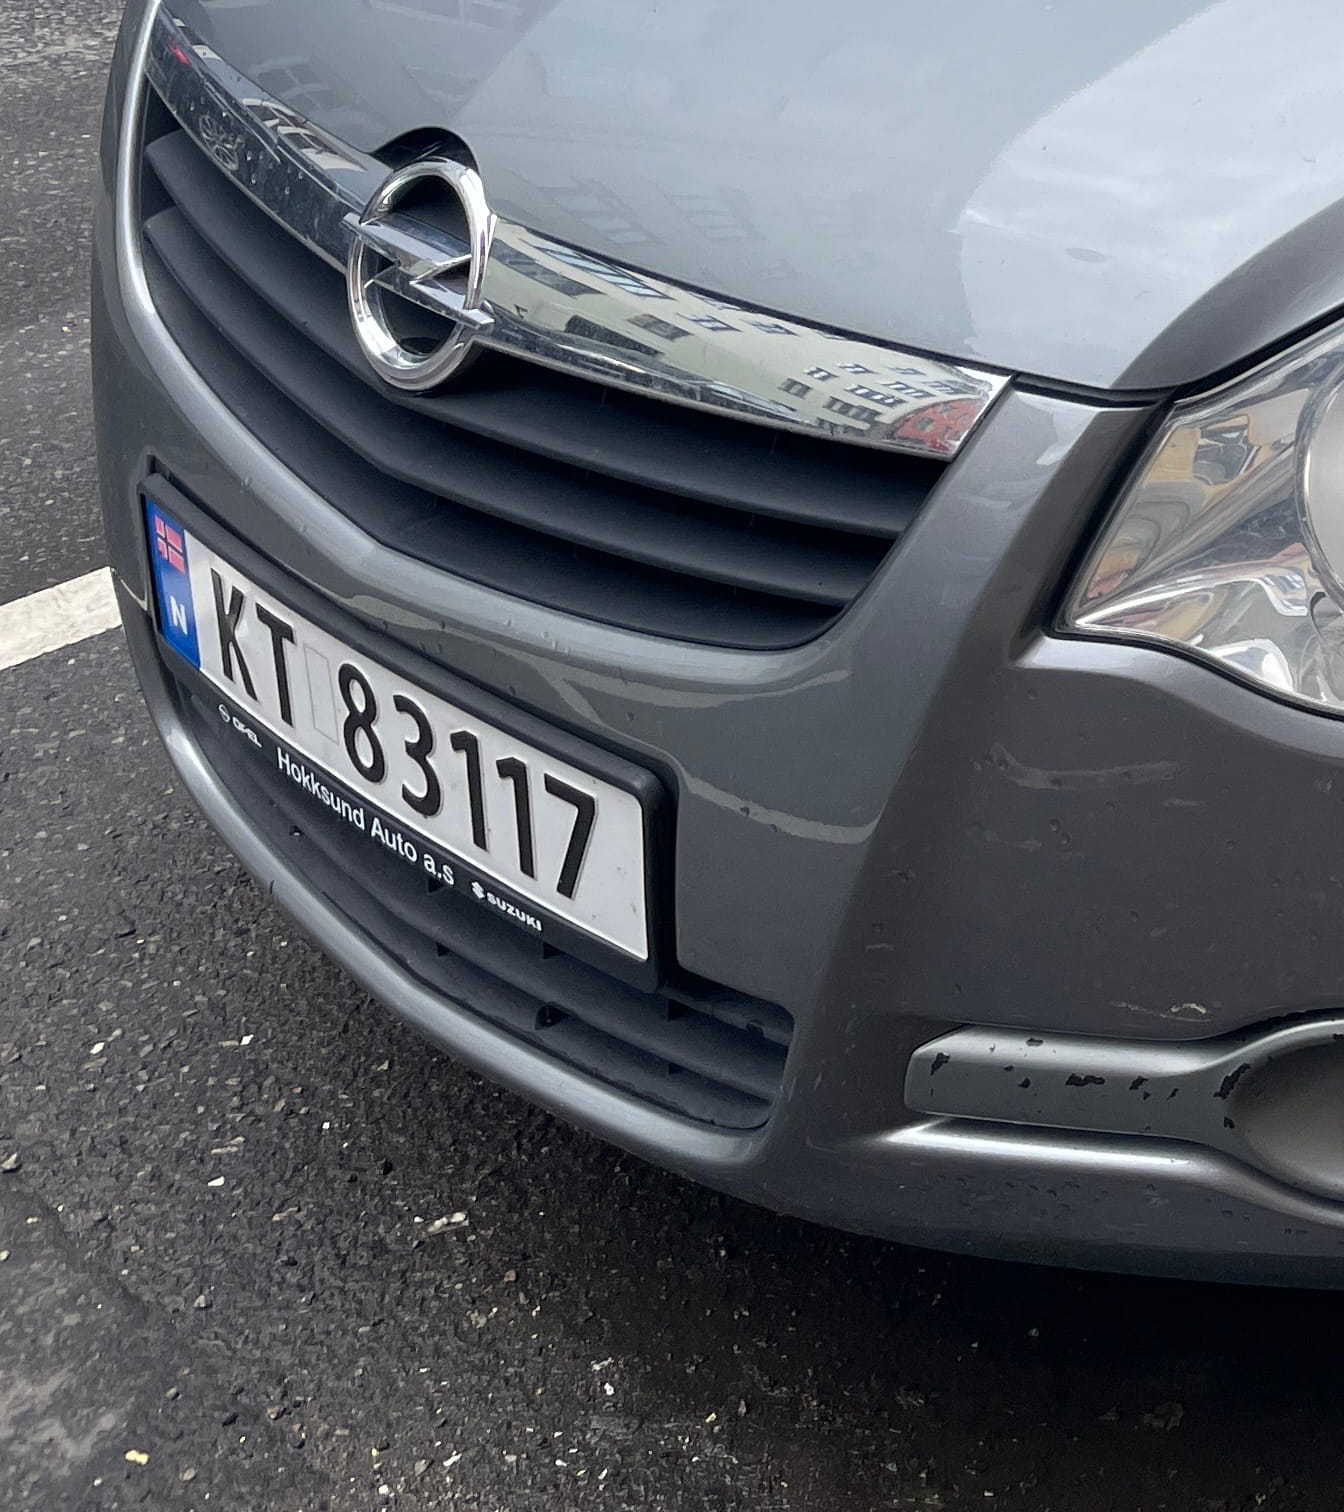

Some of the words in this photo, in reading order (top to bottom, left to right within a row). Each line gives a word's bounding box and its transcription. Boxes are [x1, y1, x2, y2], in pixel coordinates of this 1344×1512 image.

[169, 594, 189, 636] N
[209, 567, 297, 728] KT
[337, 662, 599, 901] 83117
[277, 747, 365, 831] Hokksund
[371, 816, 418, 863] Auto
[423, 852, 455, 886] a.s
[486, 891, 543, 932] SUZUKI
